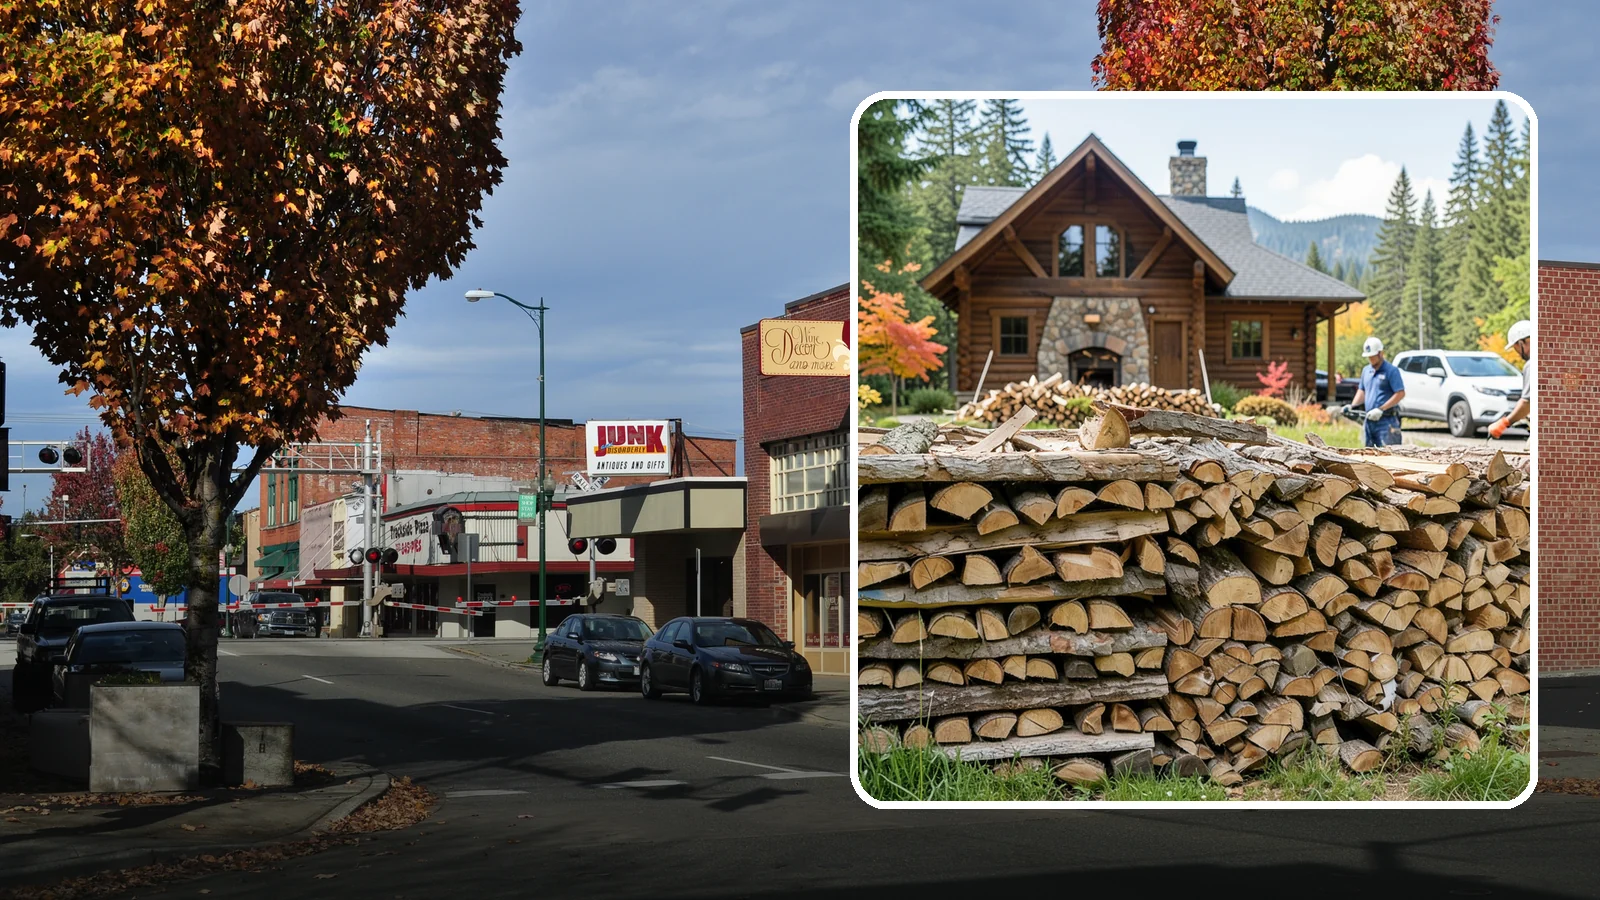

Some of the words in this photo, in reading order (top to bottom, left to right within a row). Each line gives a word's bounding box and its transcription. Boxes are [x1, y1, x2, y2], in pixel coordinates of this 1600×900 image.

[596, 425, 664, 456] JUNK
[607, 446, 646, 454] DISORDERLY
[597, 461, 628, 470] ANTIQUES
[631, 460, 644, 470] AND
[647, 460, 665, 469] GIFTS
[590, 476, 608, 492] SING
[390, 521, 413, 540] Trackside
[414, 519, 429, 535] Pizza
